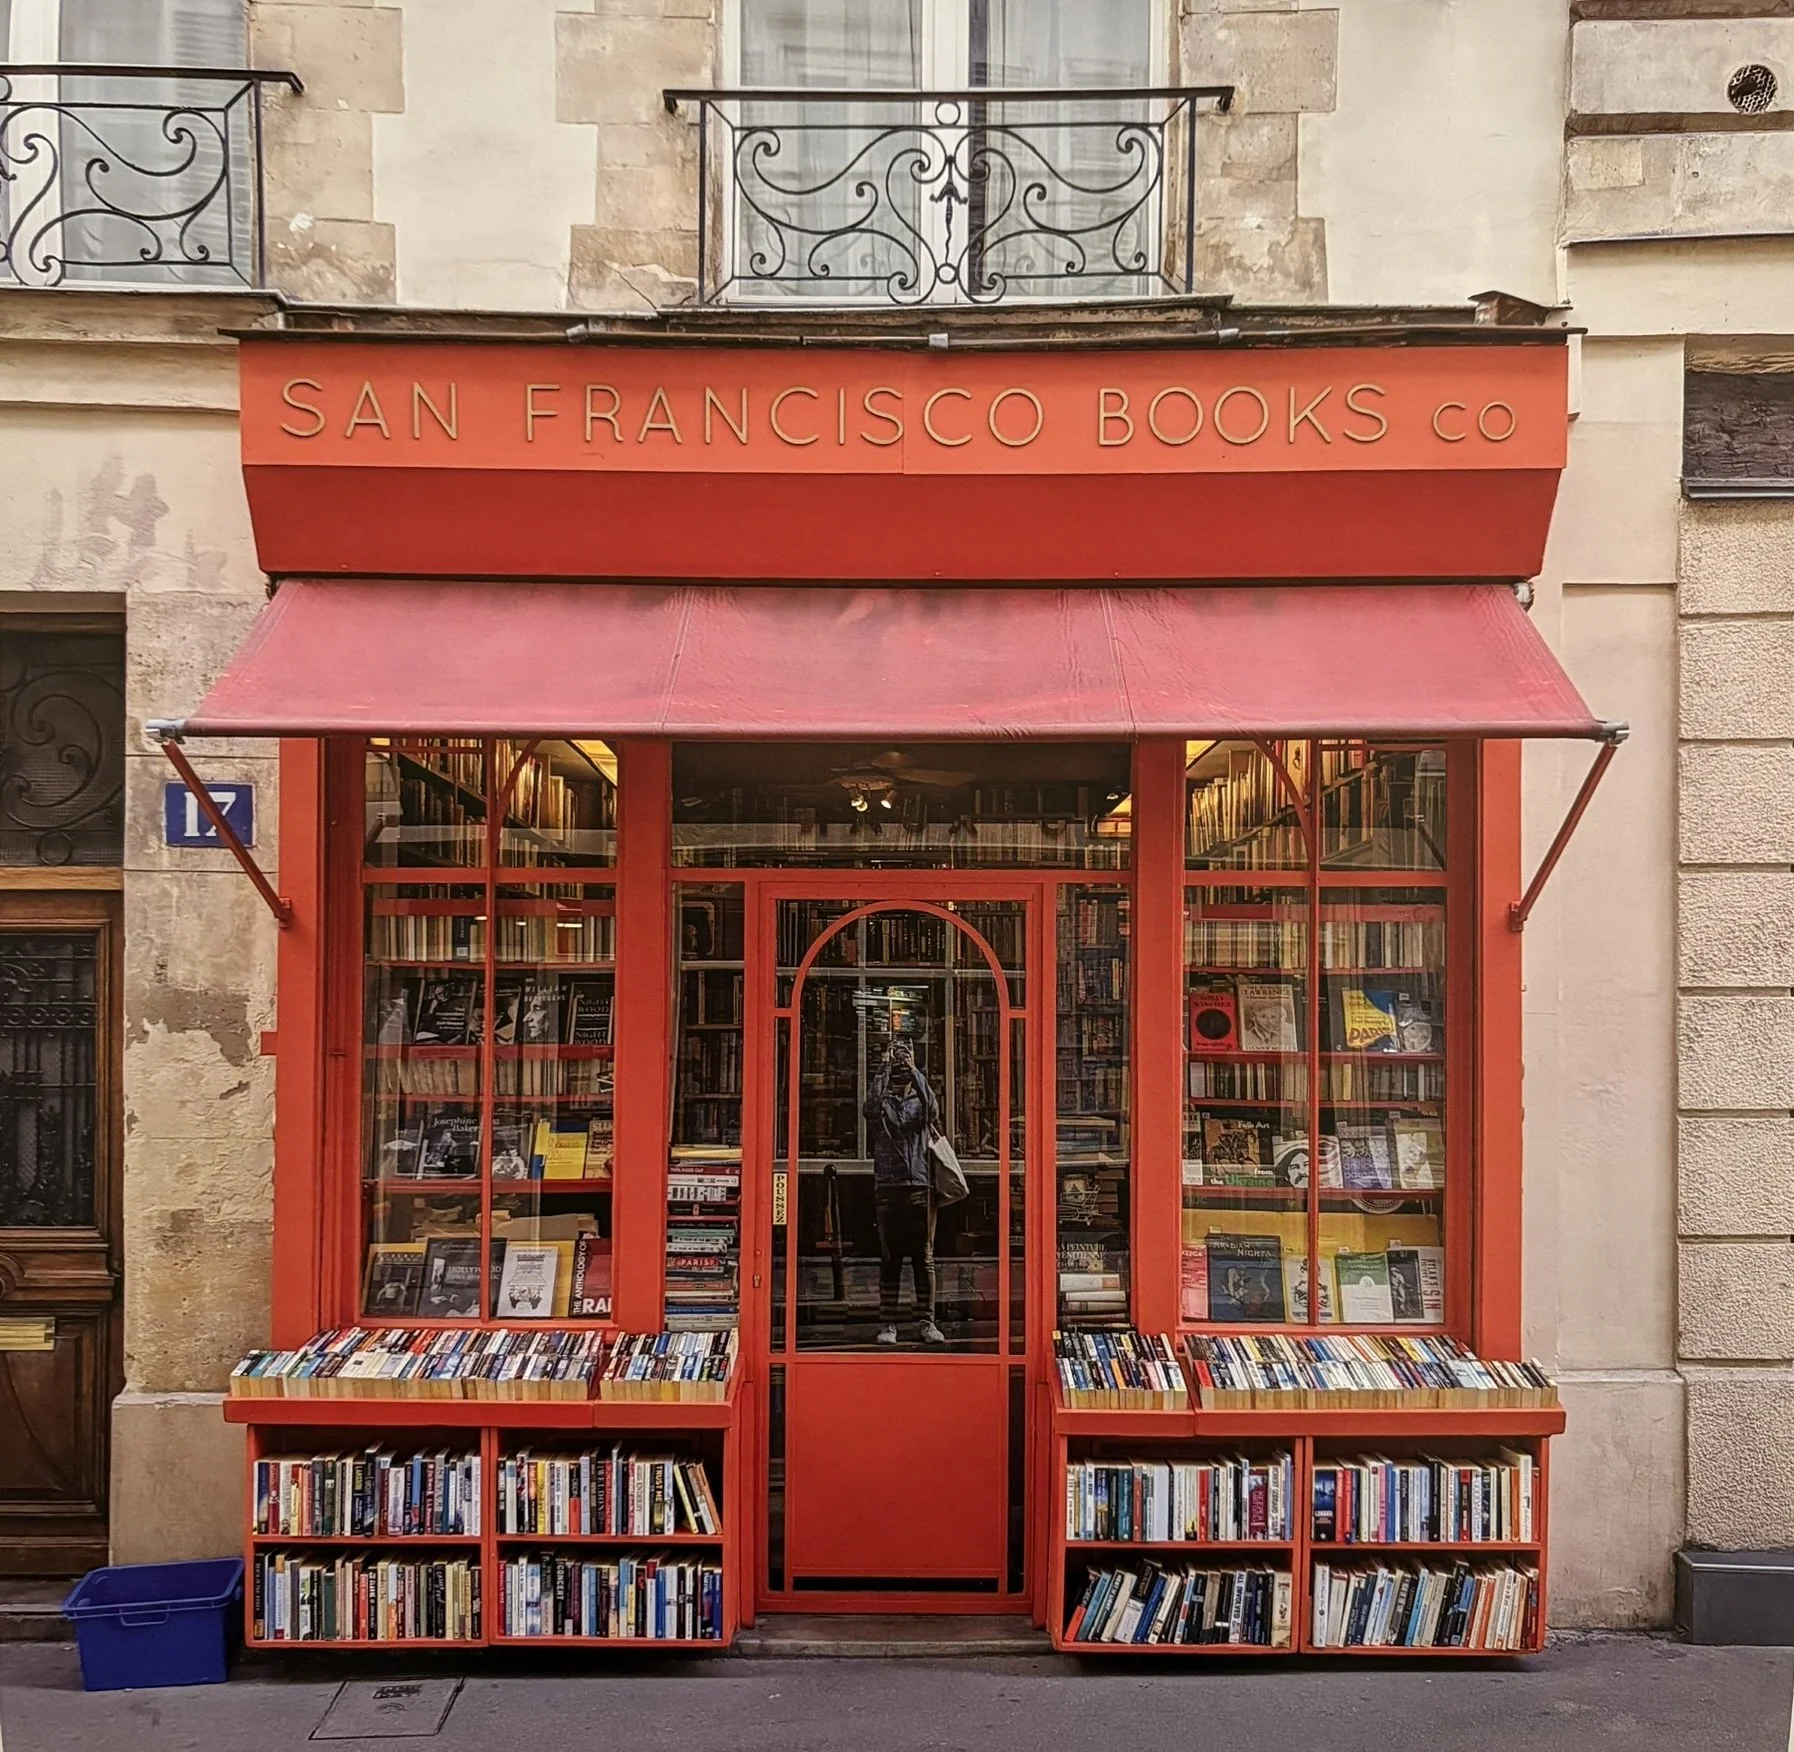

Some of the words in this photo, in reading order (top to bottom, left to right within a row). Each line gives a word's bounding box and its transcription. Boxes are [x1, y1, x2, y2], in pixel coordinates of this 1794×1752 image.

[280, 378, 458, 441] SAN
[526, 383, 1045, 447] FRANCISCO
[1098, 383, 1388, 447] BOOKS
[184, 791, 237, 837] 17
[579, 1240, 587, 1251] OF
[574, 1251, 586, 1299] ANTHOLOGY
[573, 1300, 582, 1314] THE
[556, 1564, 564, 1600] CONCERT
